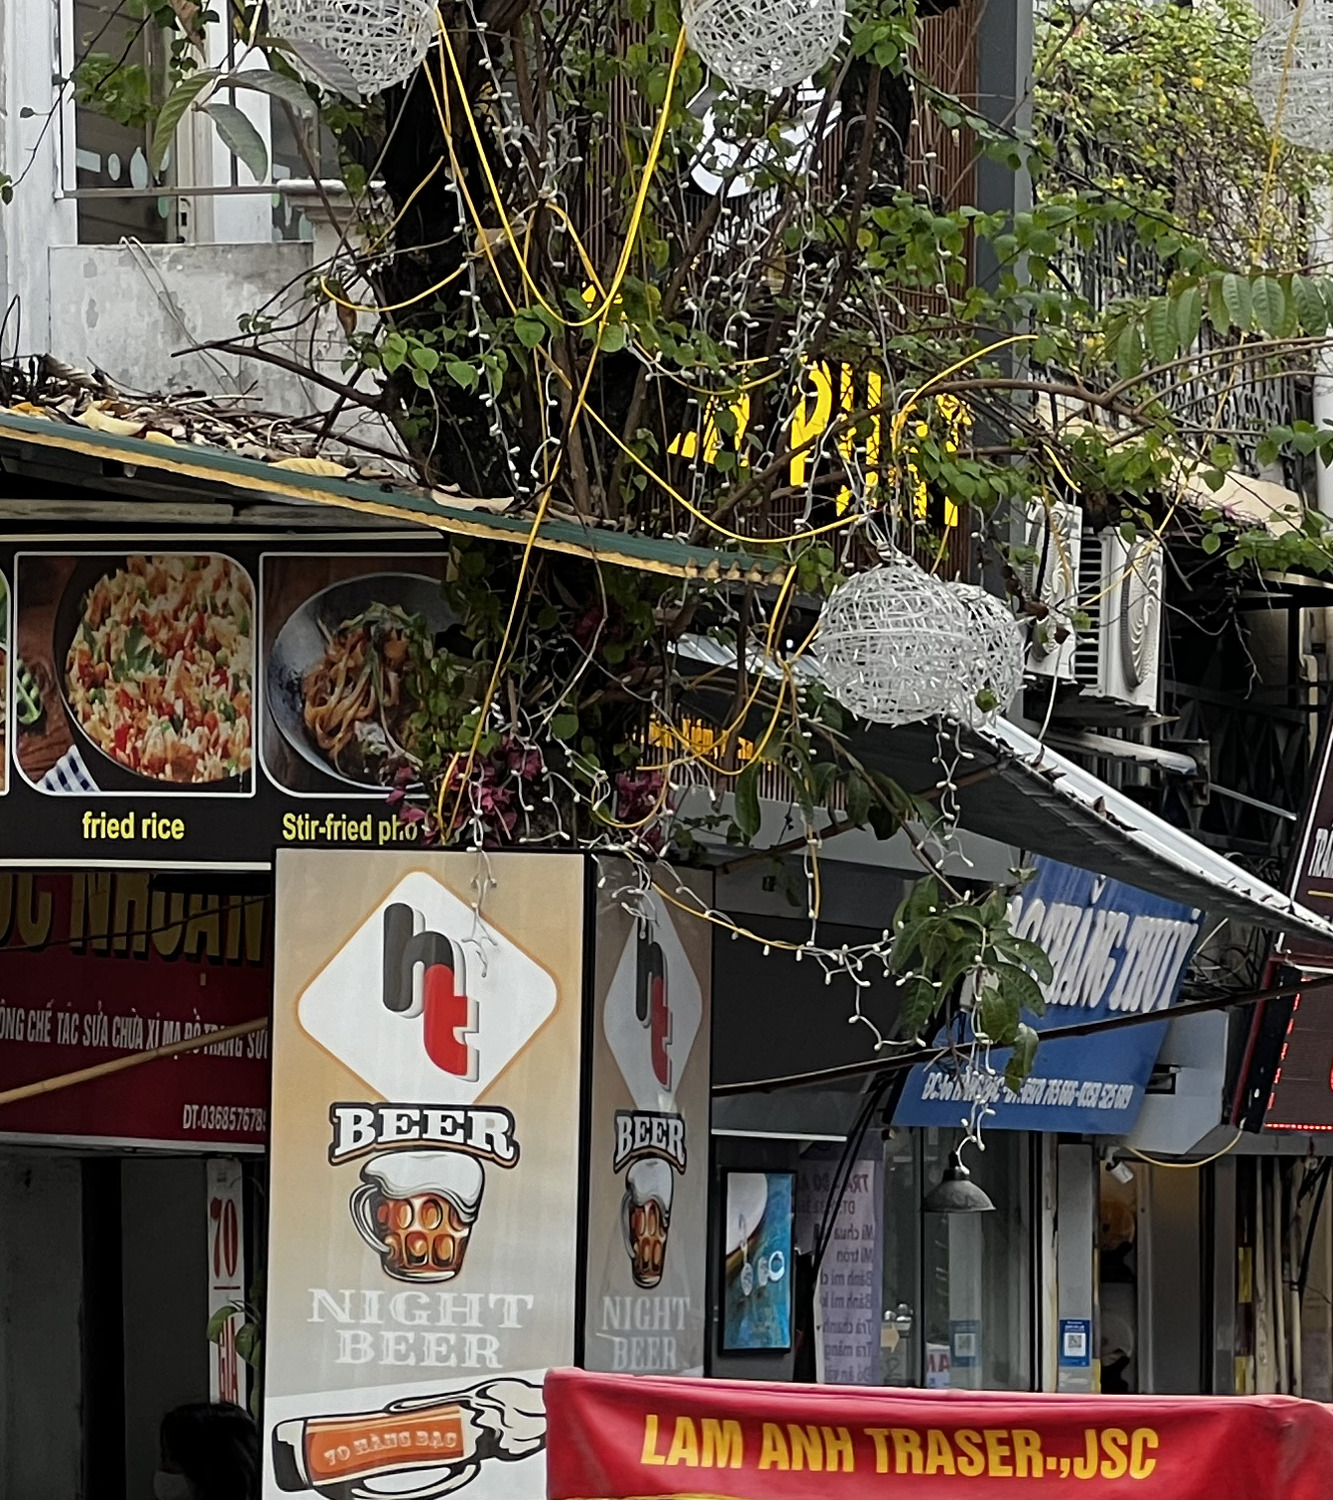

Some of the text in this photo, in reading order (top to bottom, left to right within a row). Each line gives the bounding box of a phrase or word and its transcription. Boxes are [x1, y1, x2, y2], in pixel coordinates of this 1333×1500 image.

[82, 810, 185, 840] fried rice
[281, 811, 373, 842] Stir-fried
[333, 1105, 517, 1161] BEER
[616, 1113, 686, 1166] BEER
[307, 1288, 534, 1329] NIGHT
[601, 1294, 691, 1332] NIGHT
[335, 1329, 504, 1369] BEER
[610, 1335, 678, 1371] BEER
[323, 1444, 352, 1467] 70
[640, 1411, 743, 1471] LAM
[758, 1425, 857, 1474] ANH
